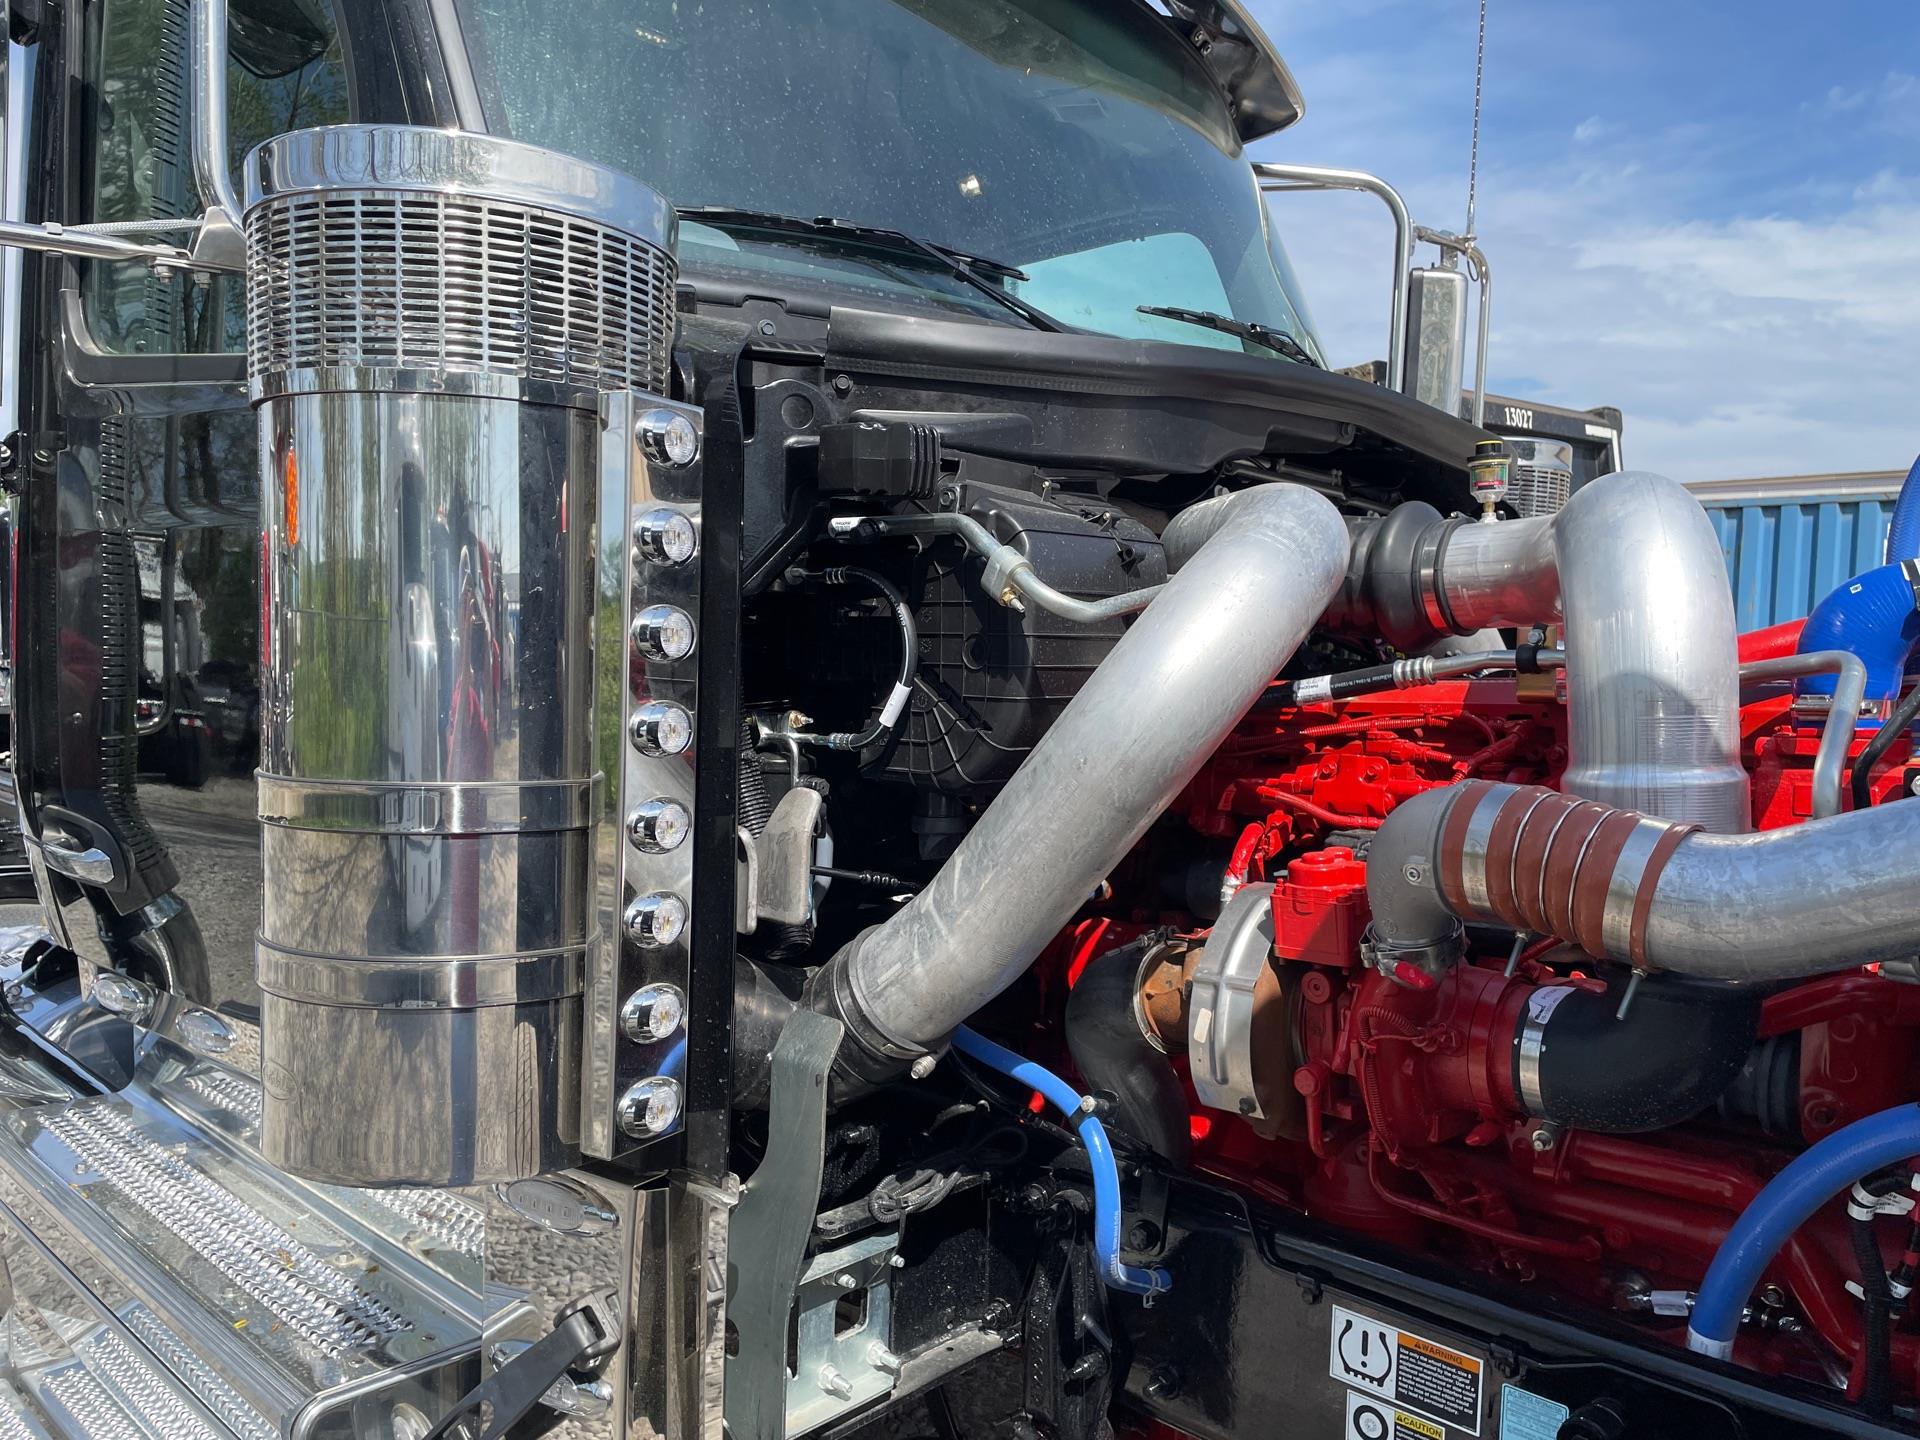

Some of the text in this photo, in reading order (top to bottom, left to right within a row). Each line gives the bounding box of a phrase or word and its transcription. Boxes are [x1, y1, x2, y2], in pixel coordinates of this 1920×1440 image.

[1504, 407, 1533, 430] 13027
[1421, 1343, 1463, 1365] WARNING
[1403, 1416, 1441, 1438] CAUTION
